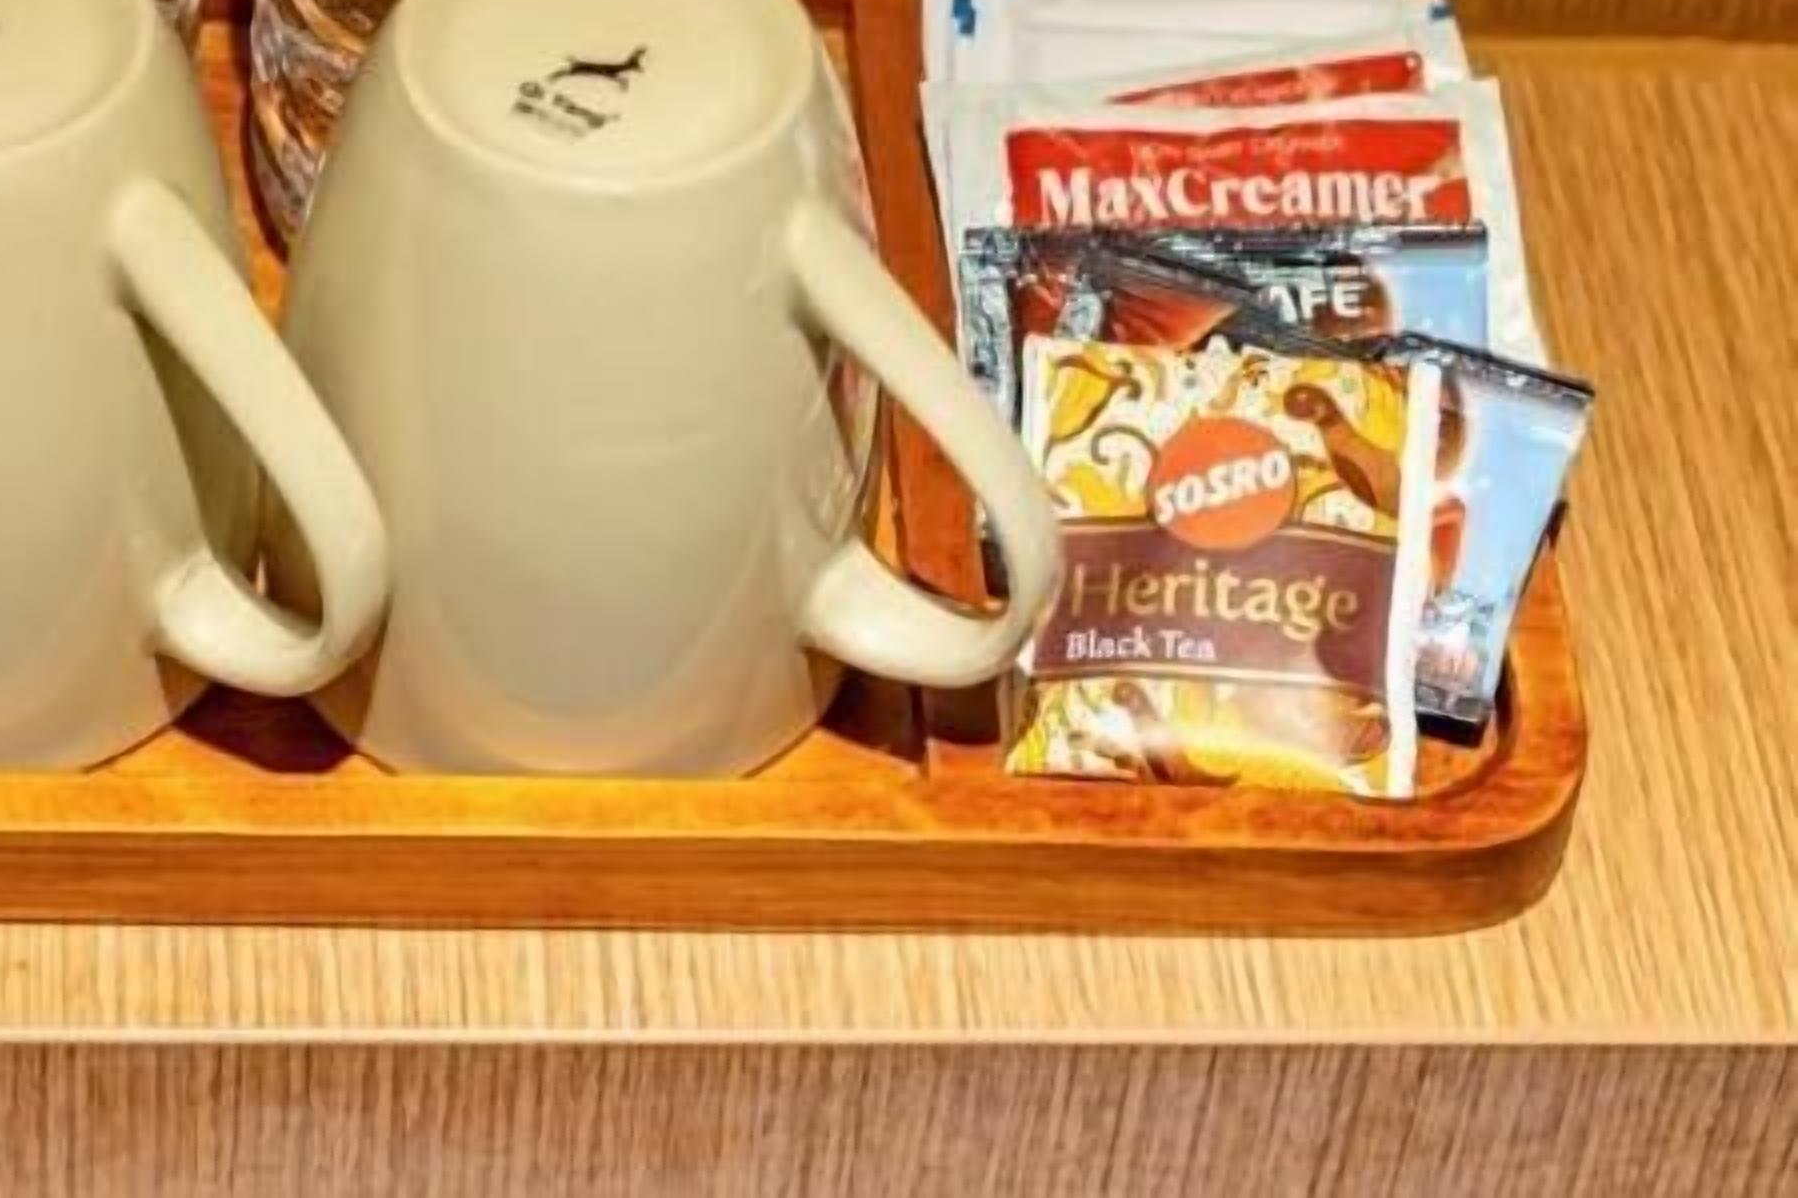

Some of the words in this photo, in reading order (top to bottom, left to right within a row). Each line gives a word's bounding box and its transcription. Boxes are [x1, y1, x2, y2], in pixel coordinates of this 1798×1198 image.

[1036, 166, 1442, 226] MaxCreamer
[1155, 450, 1290, 524] SOSRO
[1070, 558, 1359, 642] Heritage
[1066, 625, 1152, 659] Black
[1158, 630, 1217, 660] Tea
